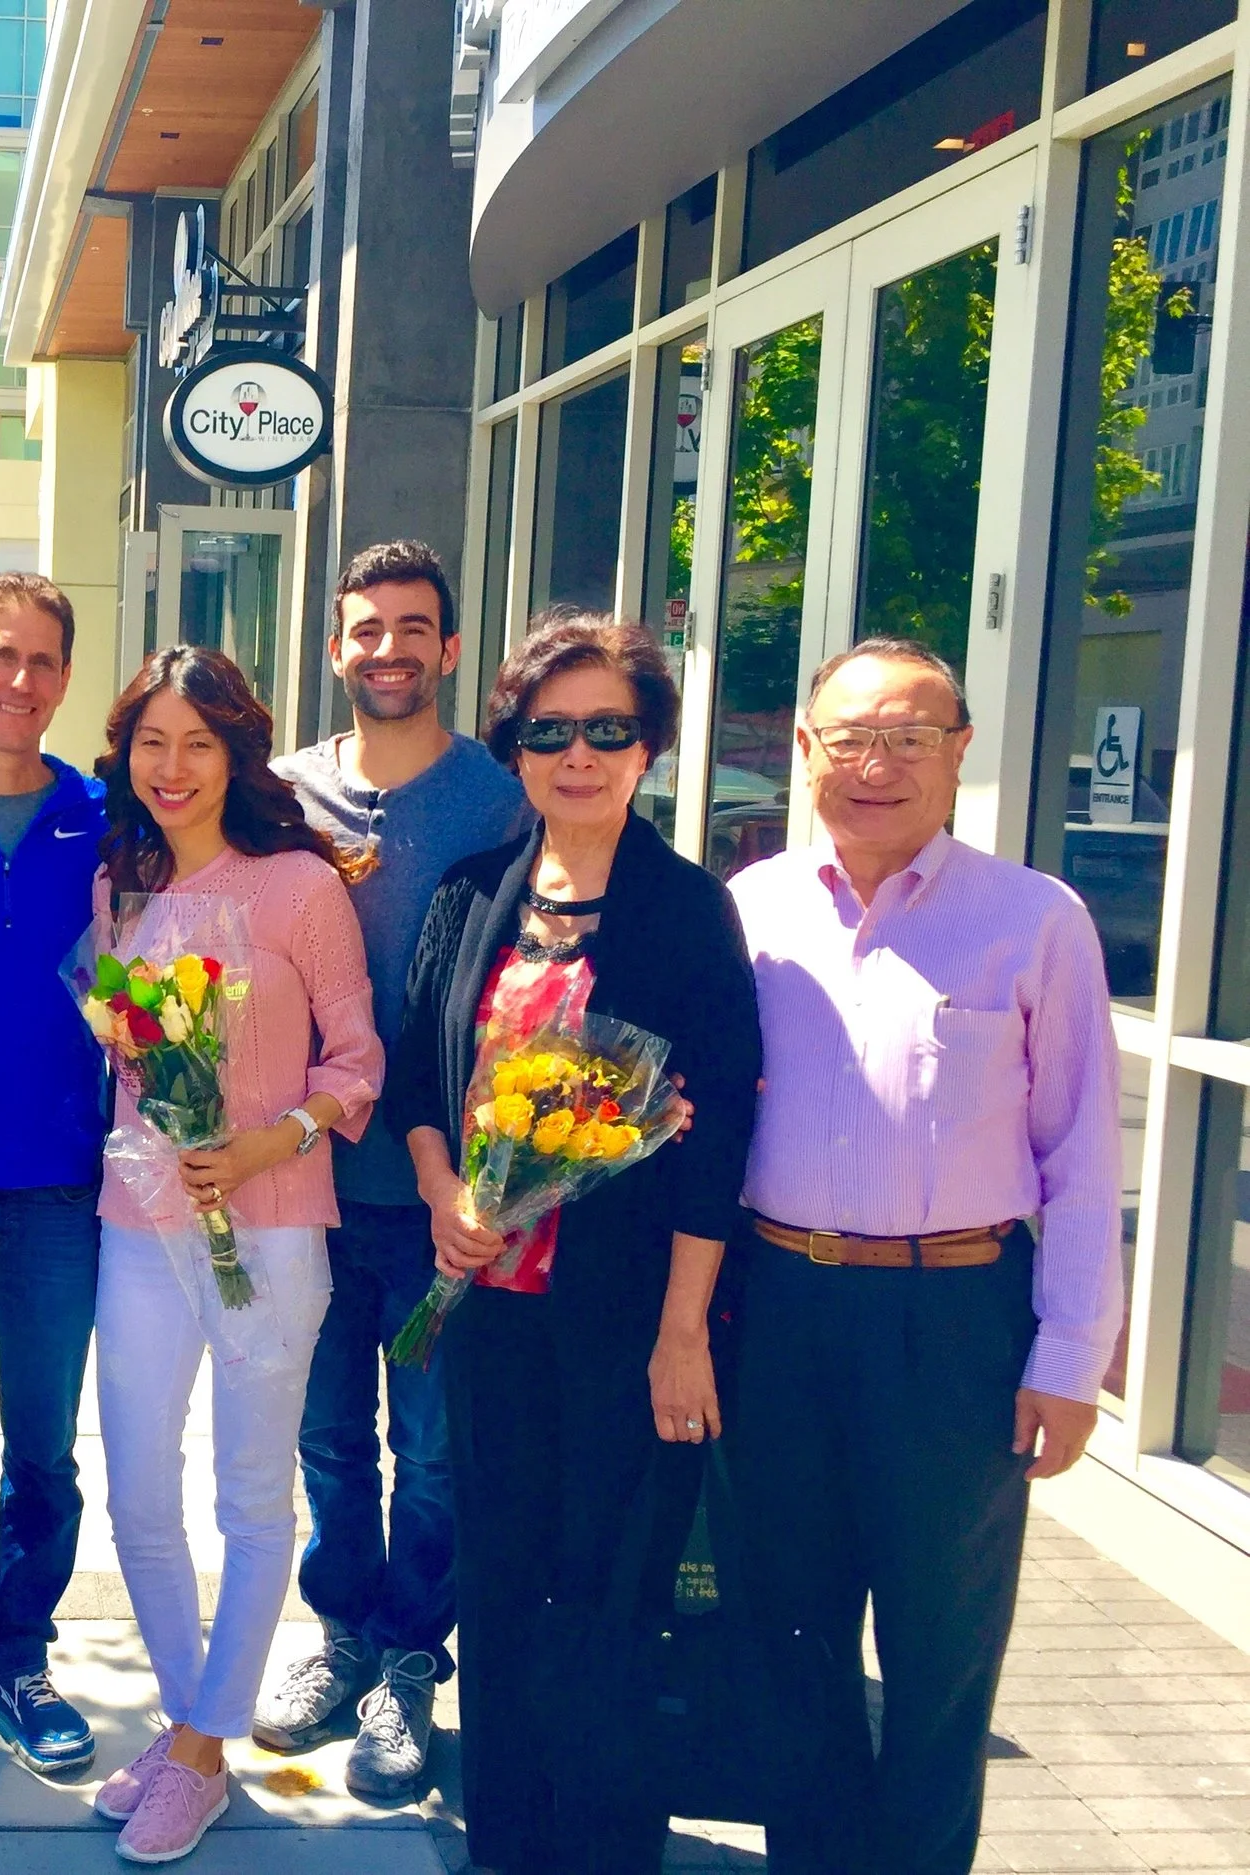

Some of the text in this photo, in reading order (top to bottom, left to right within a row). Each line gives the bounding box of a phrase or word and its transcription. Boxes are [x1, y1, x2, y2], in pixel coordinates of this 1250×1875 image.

[190, 409, 314, 440] City Place
[1092, 792, 1130, 805] ENTRANCE
